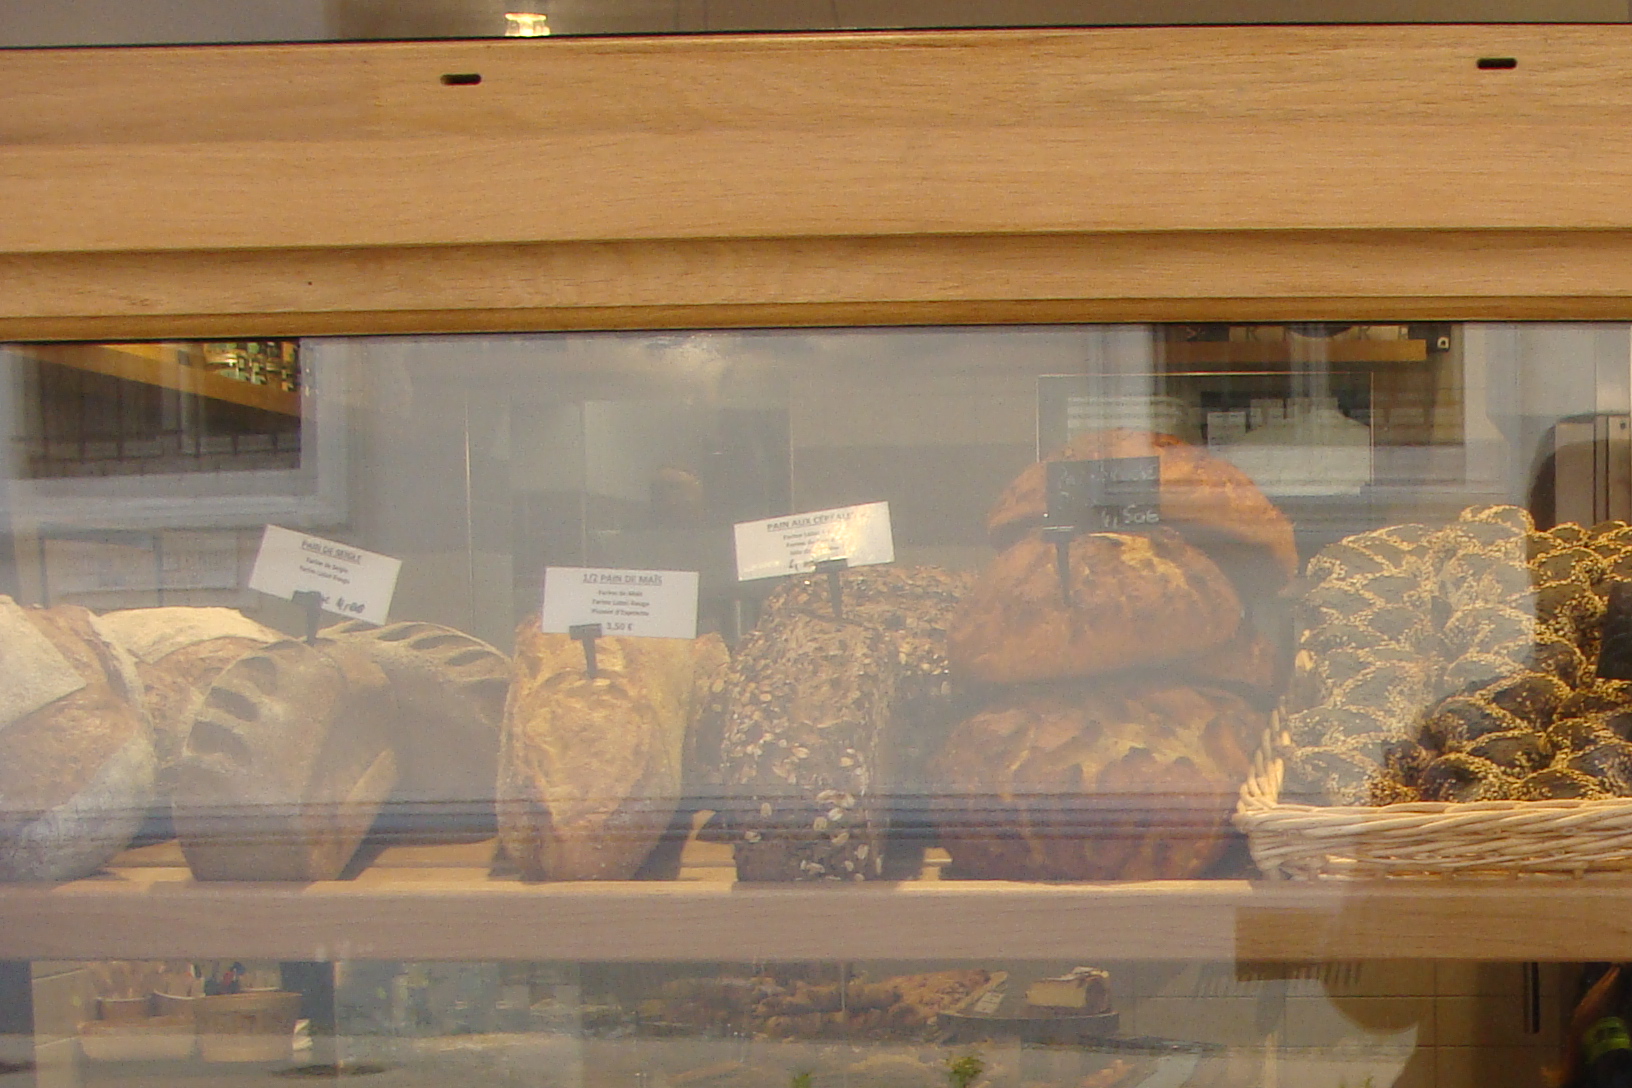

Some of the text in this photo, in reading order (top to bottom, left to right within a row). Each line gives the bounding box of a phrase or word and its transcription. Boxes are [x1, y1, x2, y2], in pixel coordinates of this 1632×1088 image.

[767, 511, 856, 532] PAIN AUX CÉRÉALE
[301, 540, 362, 563] PAIN DE SEIGLE
[583, 573, 598, 584] 1/2
[600, 574, 622, 584] PAIN
[625, 575, 637, 584] DE
